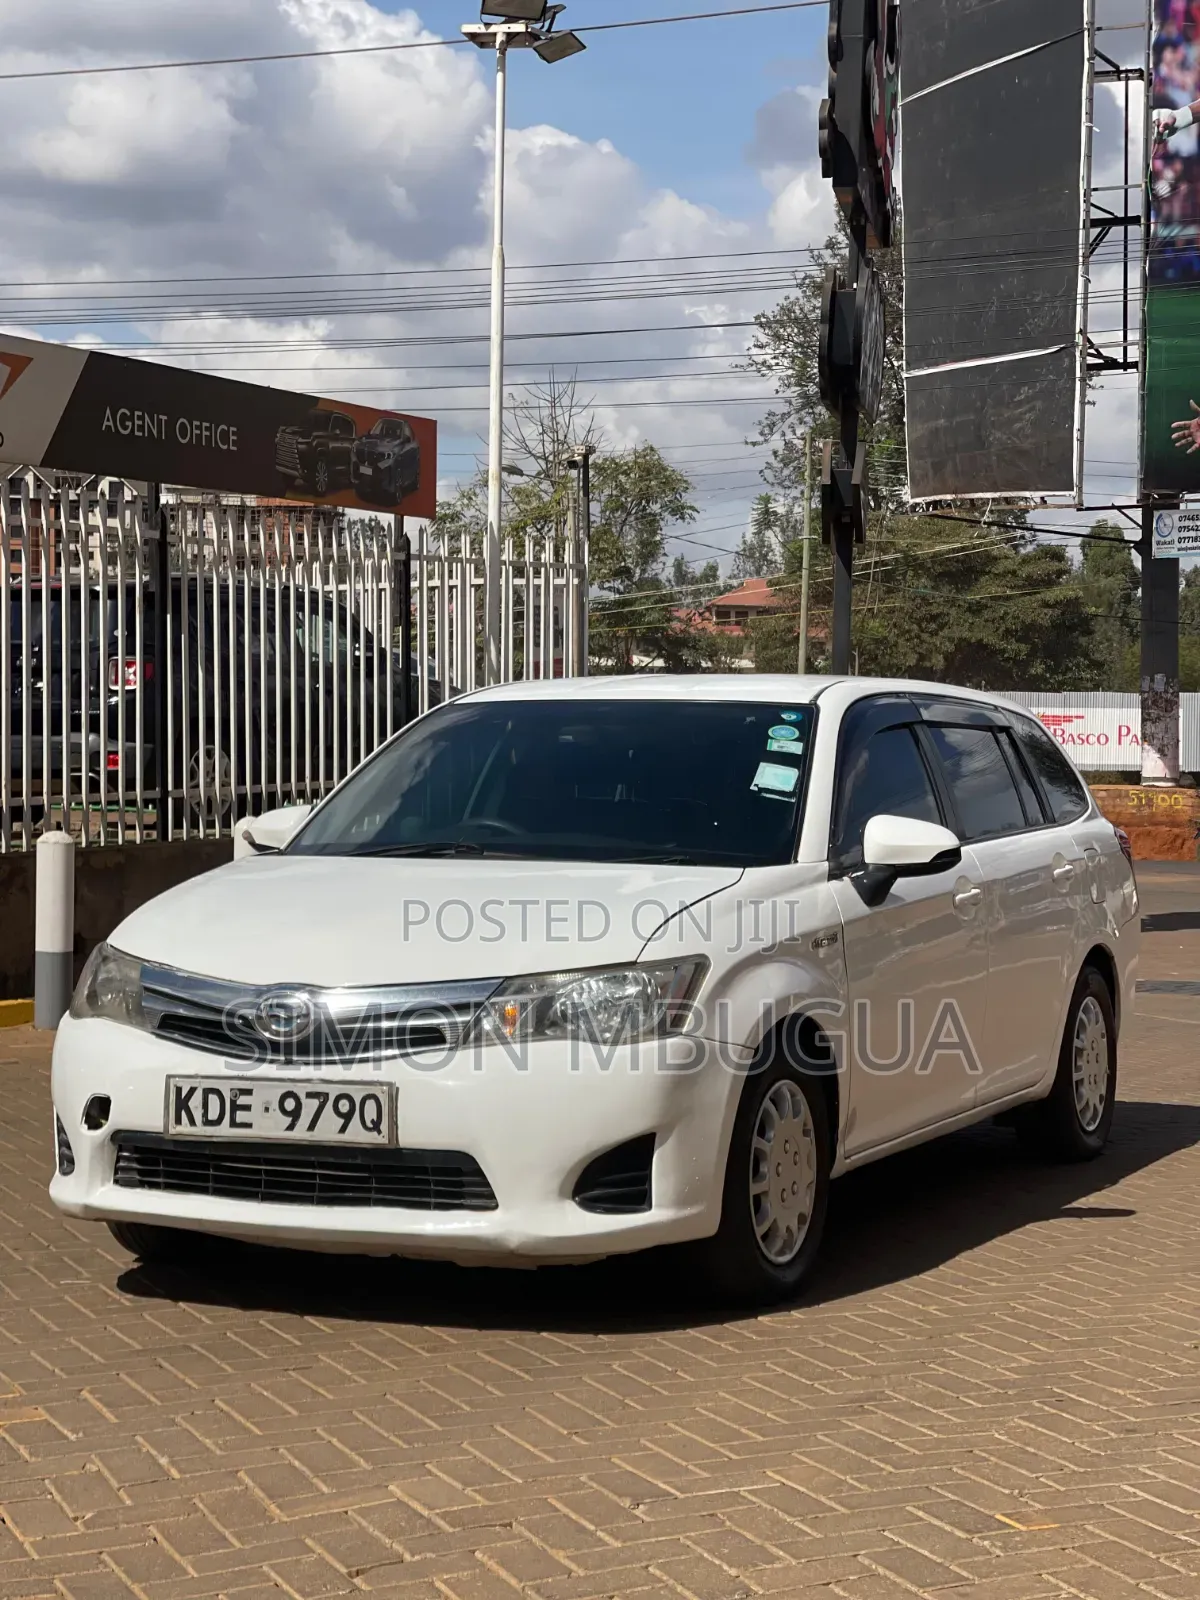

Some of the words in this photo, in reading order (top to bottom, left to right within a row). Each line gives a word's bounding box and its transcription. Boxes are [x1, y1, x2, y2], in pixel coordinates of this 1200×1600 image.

[102, 406, 167, 440] AGENT
[175, 417, 238, 451] OFFICE
[1178, 514, 1200, 522] 07465
[174, 1086, 254, 1128] KDE
[278, 1090, 383, 1136] 979Q
